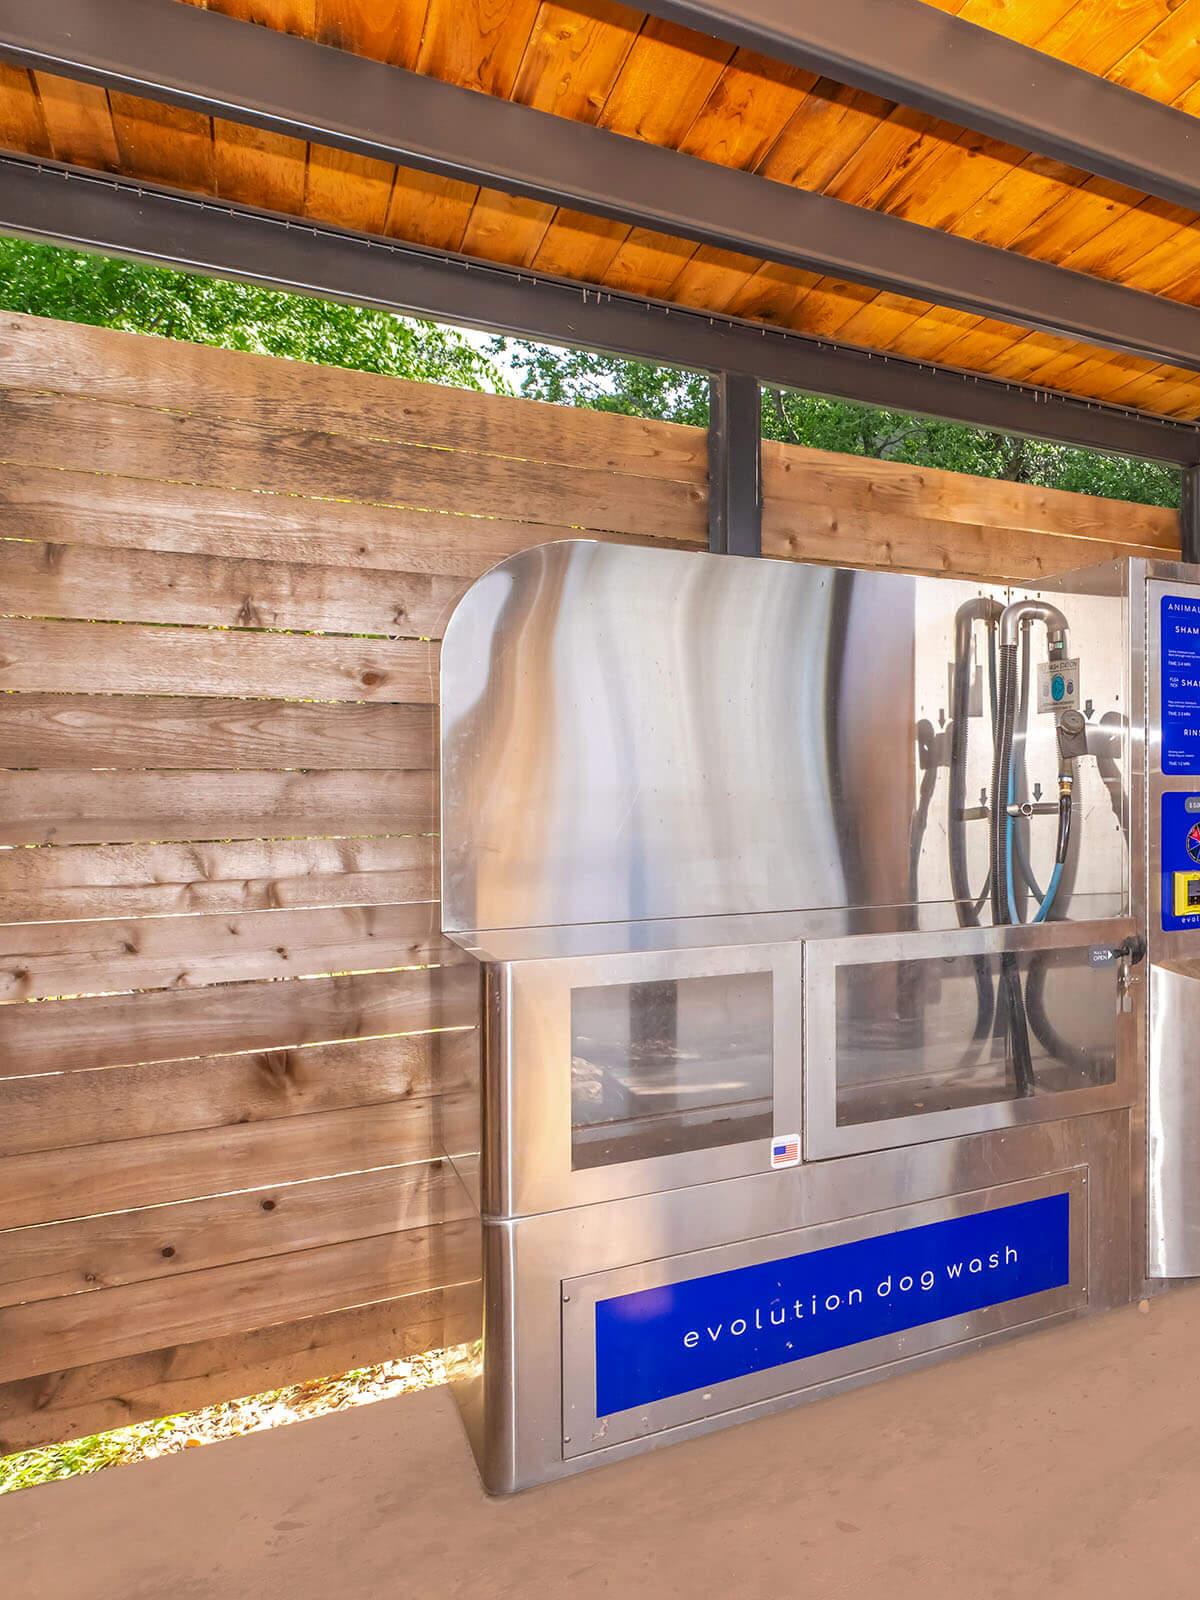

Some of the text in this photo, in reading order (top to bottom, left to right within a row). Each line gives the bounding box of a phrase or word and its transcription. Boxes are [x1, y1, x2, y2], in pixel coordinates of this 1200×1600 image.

[683, 1245, 1018, 1348] evolution dog wash
